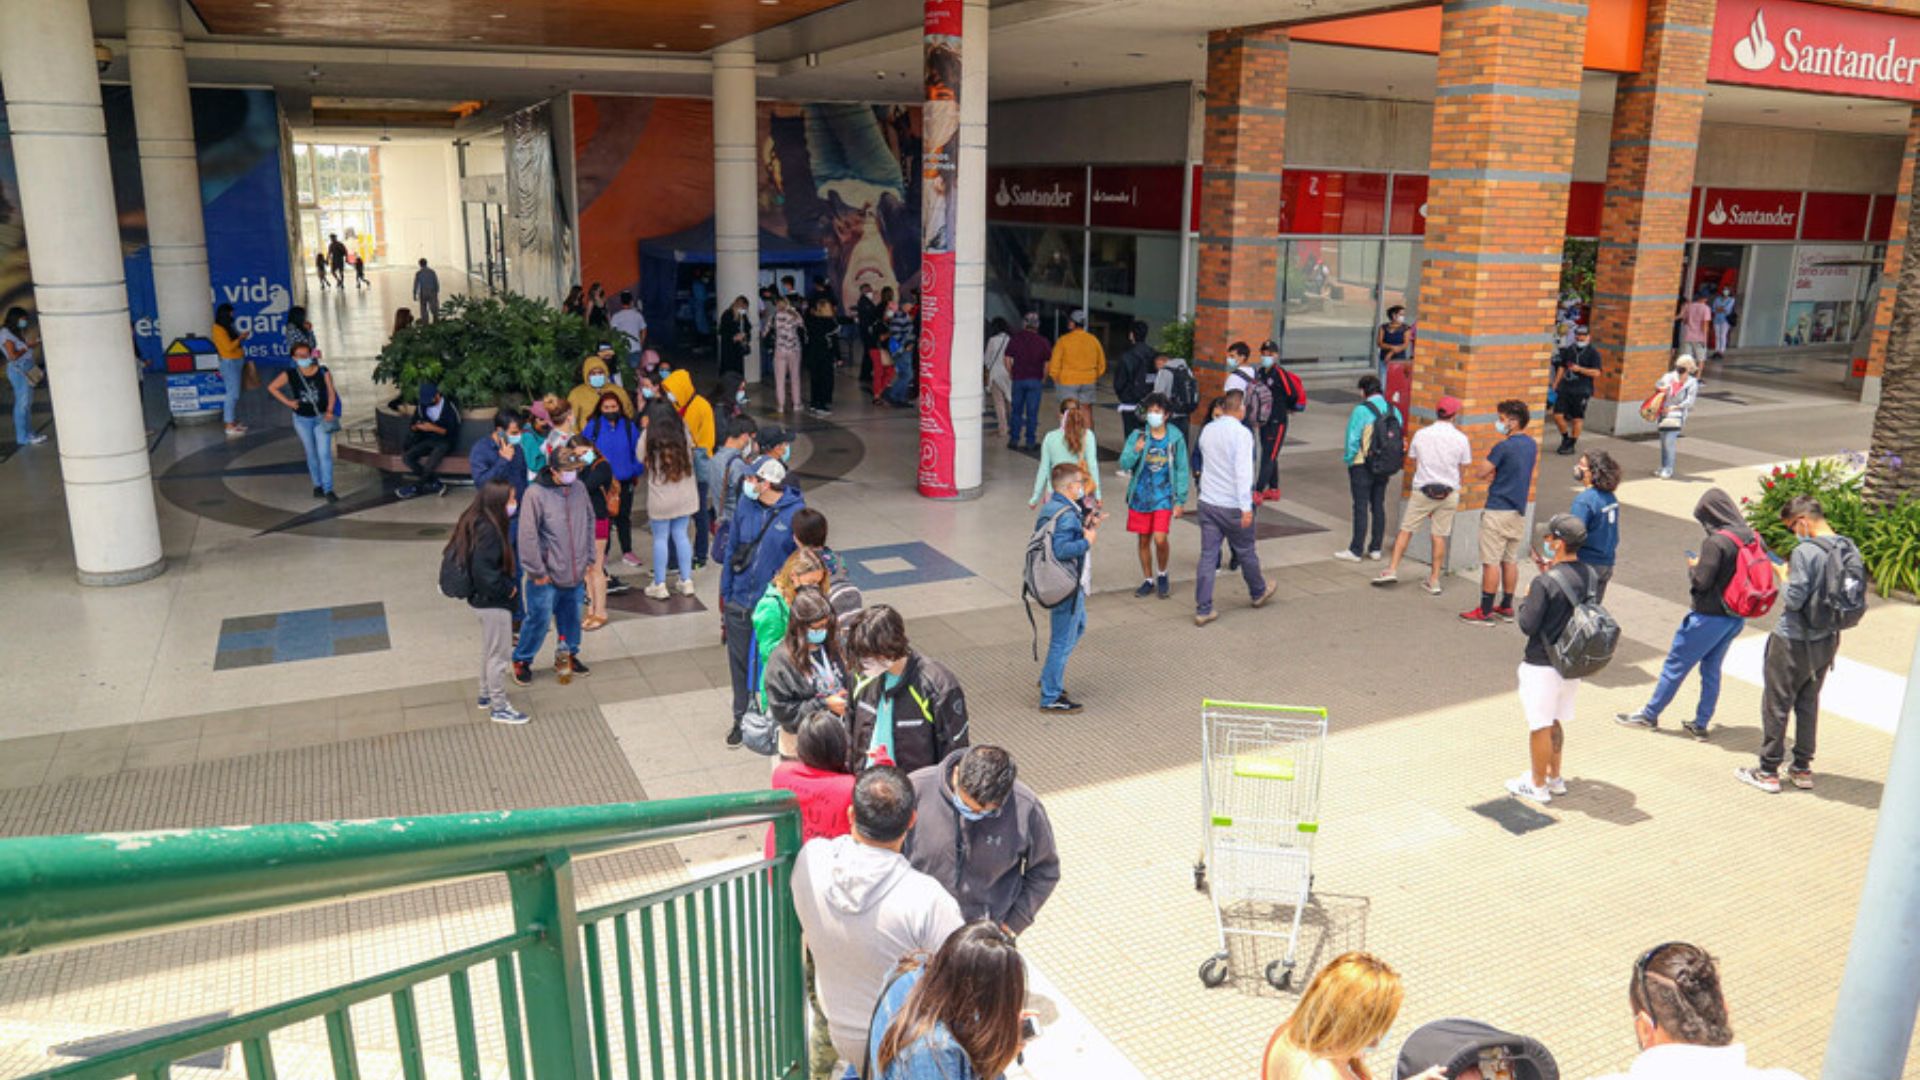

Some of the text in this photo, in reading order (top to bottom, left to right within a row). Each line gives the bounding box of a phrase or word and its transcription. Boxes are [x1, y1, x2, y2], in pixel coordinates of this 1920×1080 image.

[1779, 27, 1920, 85] Santander
[1011, 183, 1073, 207] Santander
[1728, 204, 1796, 226] Santander
[222, 276, 283, 303] vida
[235, 315, 287, 340] gar,
